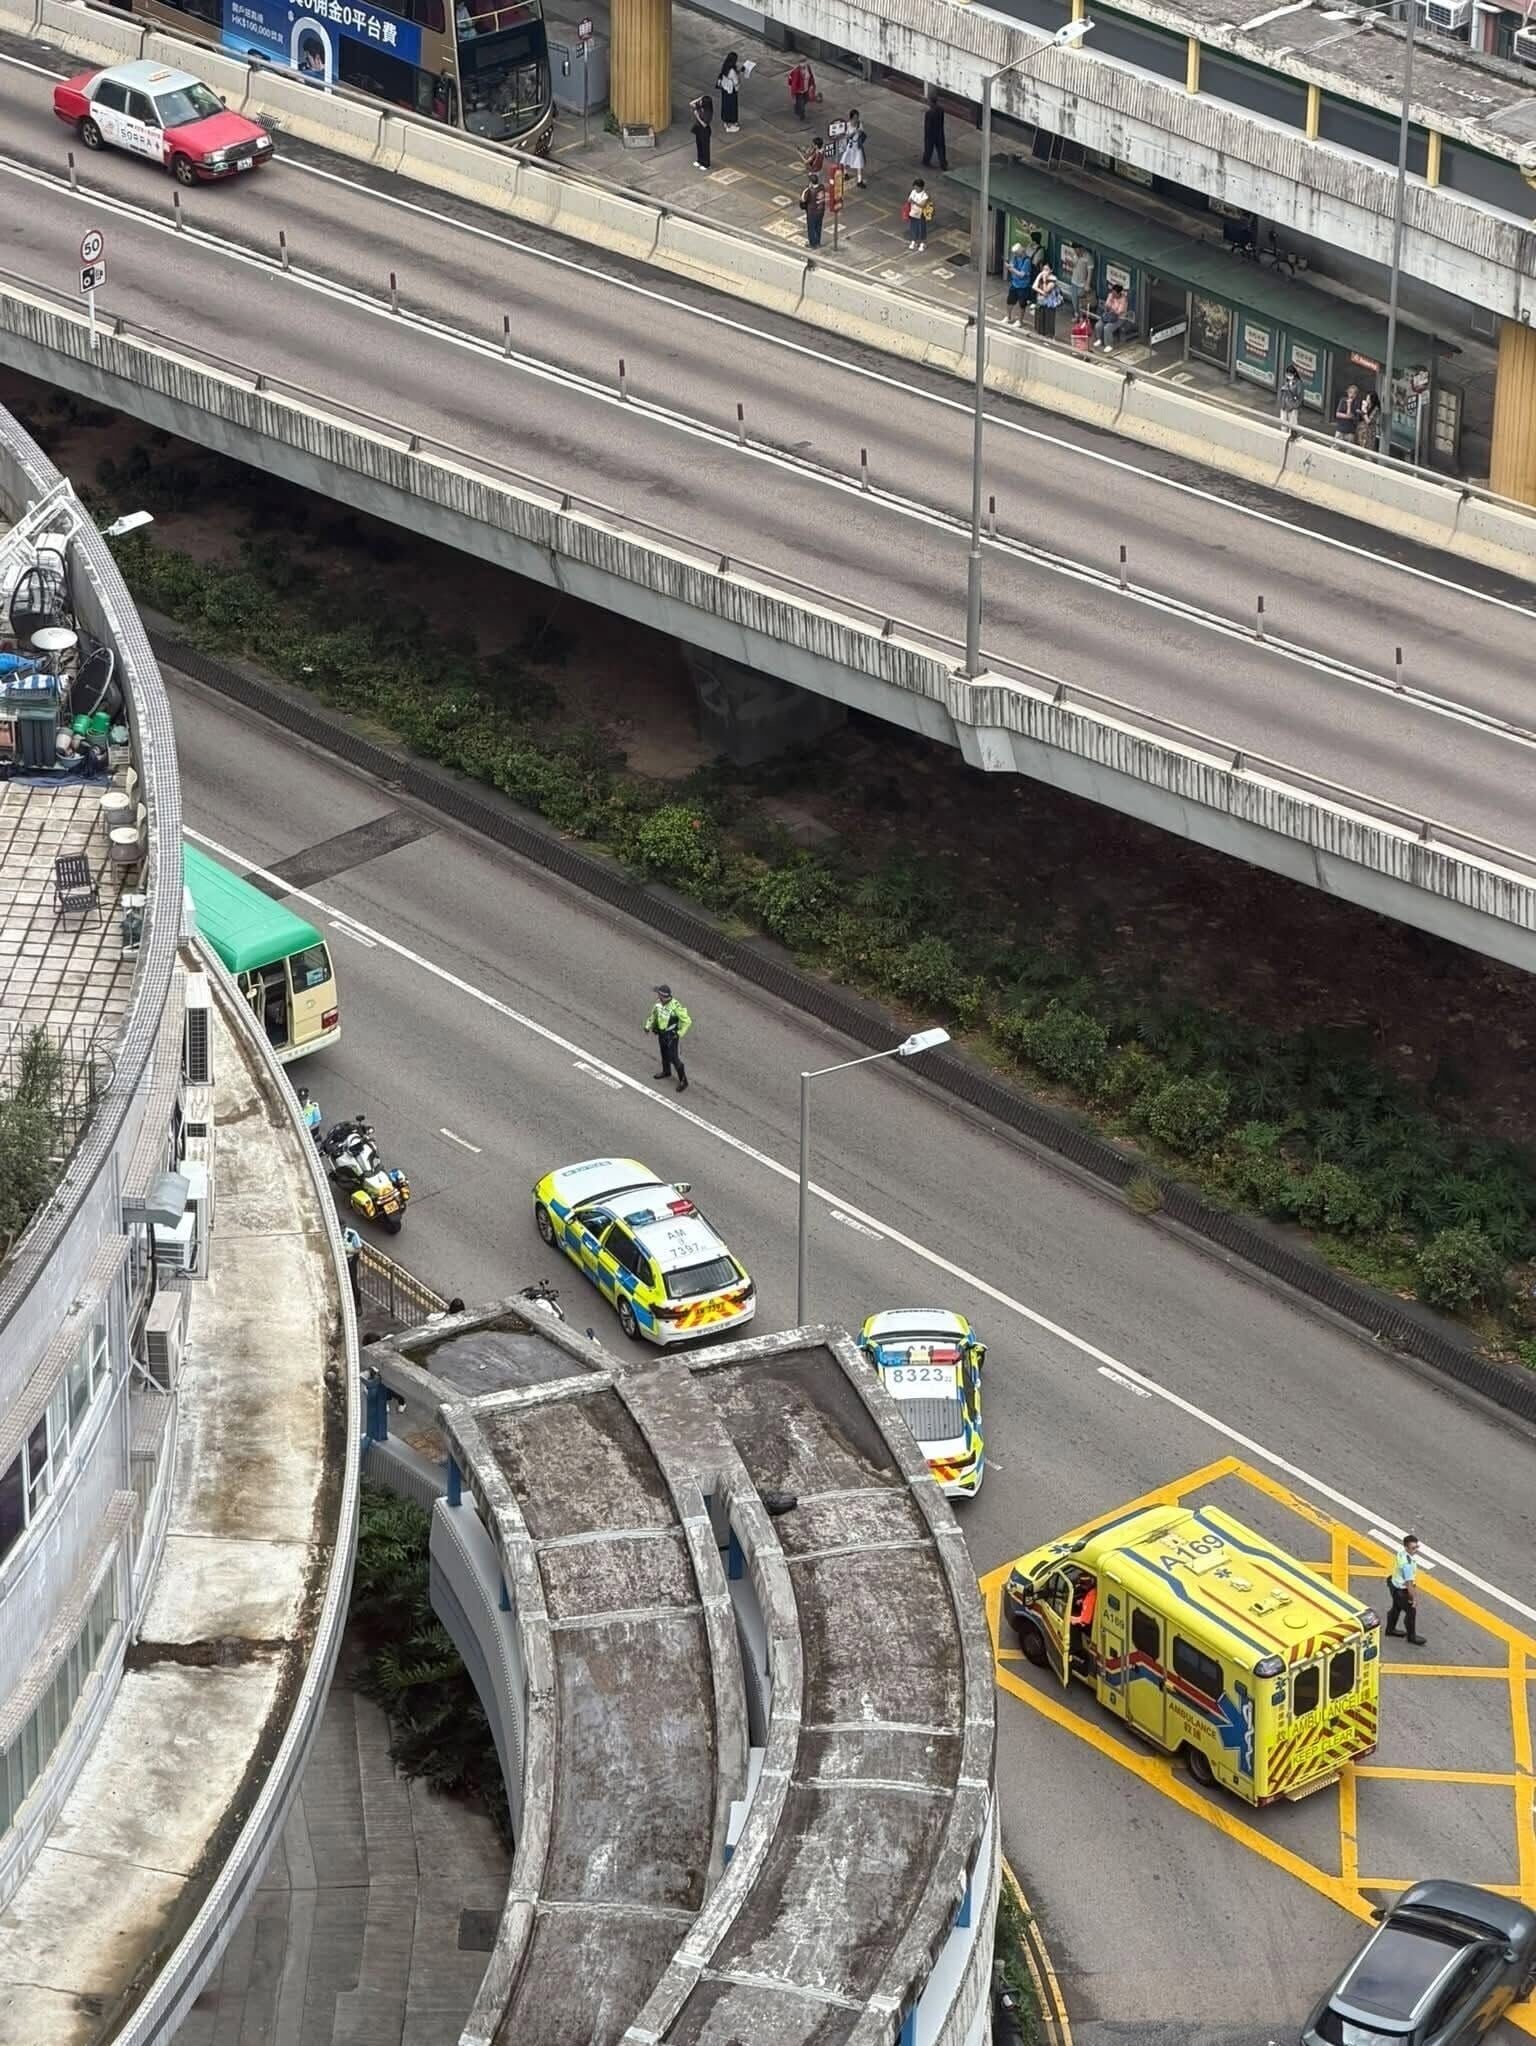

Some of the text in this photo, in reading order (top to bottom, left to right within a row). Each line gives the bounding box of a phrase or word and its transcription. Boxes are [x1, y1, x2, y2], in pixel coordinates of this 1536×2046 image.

[84, 238, 100, 256] 50
[667, 1229, 686, 1241] AM
[893, 1368, 943, 1383] 8323
[1160, 1534, 1225, 1571] A169
[1169, 1702, 1217, 1738] AMBULANCE
[1293, 1697, 1356, 1735] AMBULANCE
[1292, 1728, 1353, 1764] KEEP CLEAR
